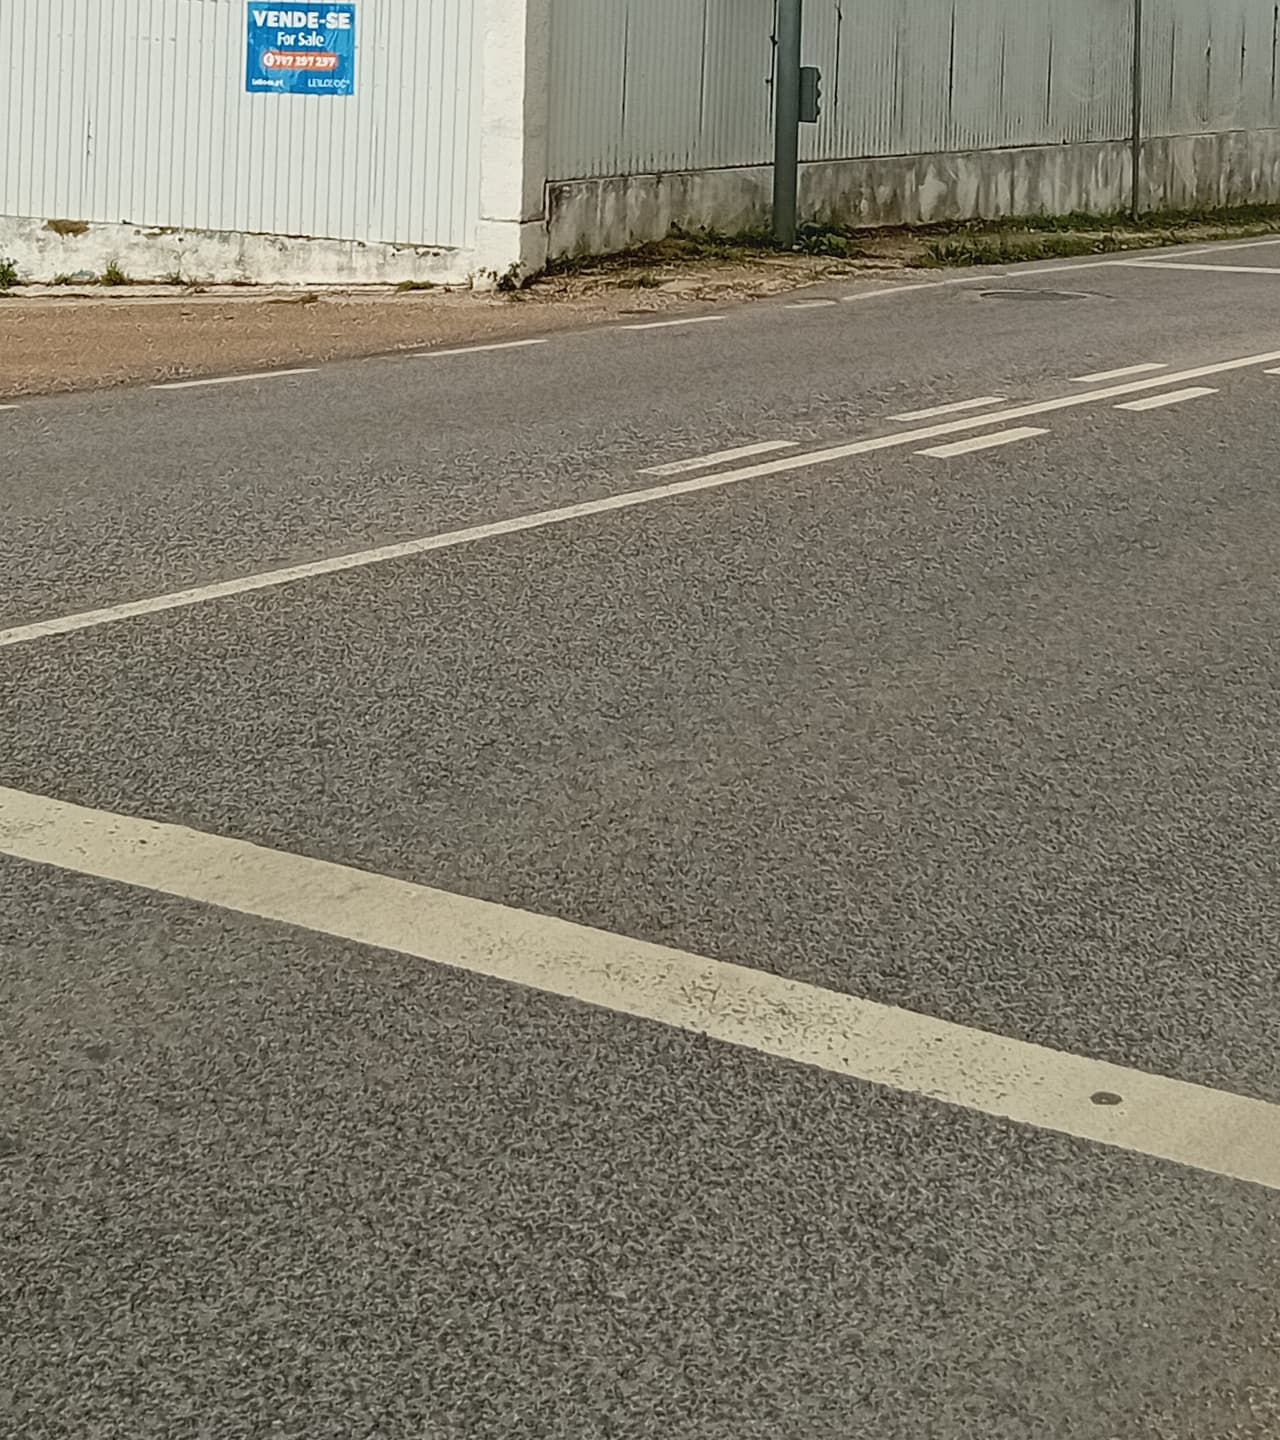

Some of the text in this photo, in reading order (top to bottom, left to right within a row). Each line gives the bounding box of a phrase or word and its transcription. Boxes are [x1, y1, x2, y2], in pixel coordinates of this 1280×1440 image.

[253, 10, 351, 29] VENDE-SE
[277, 32, 324, 47] For Sale
